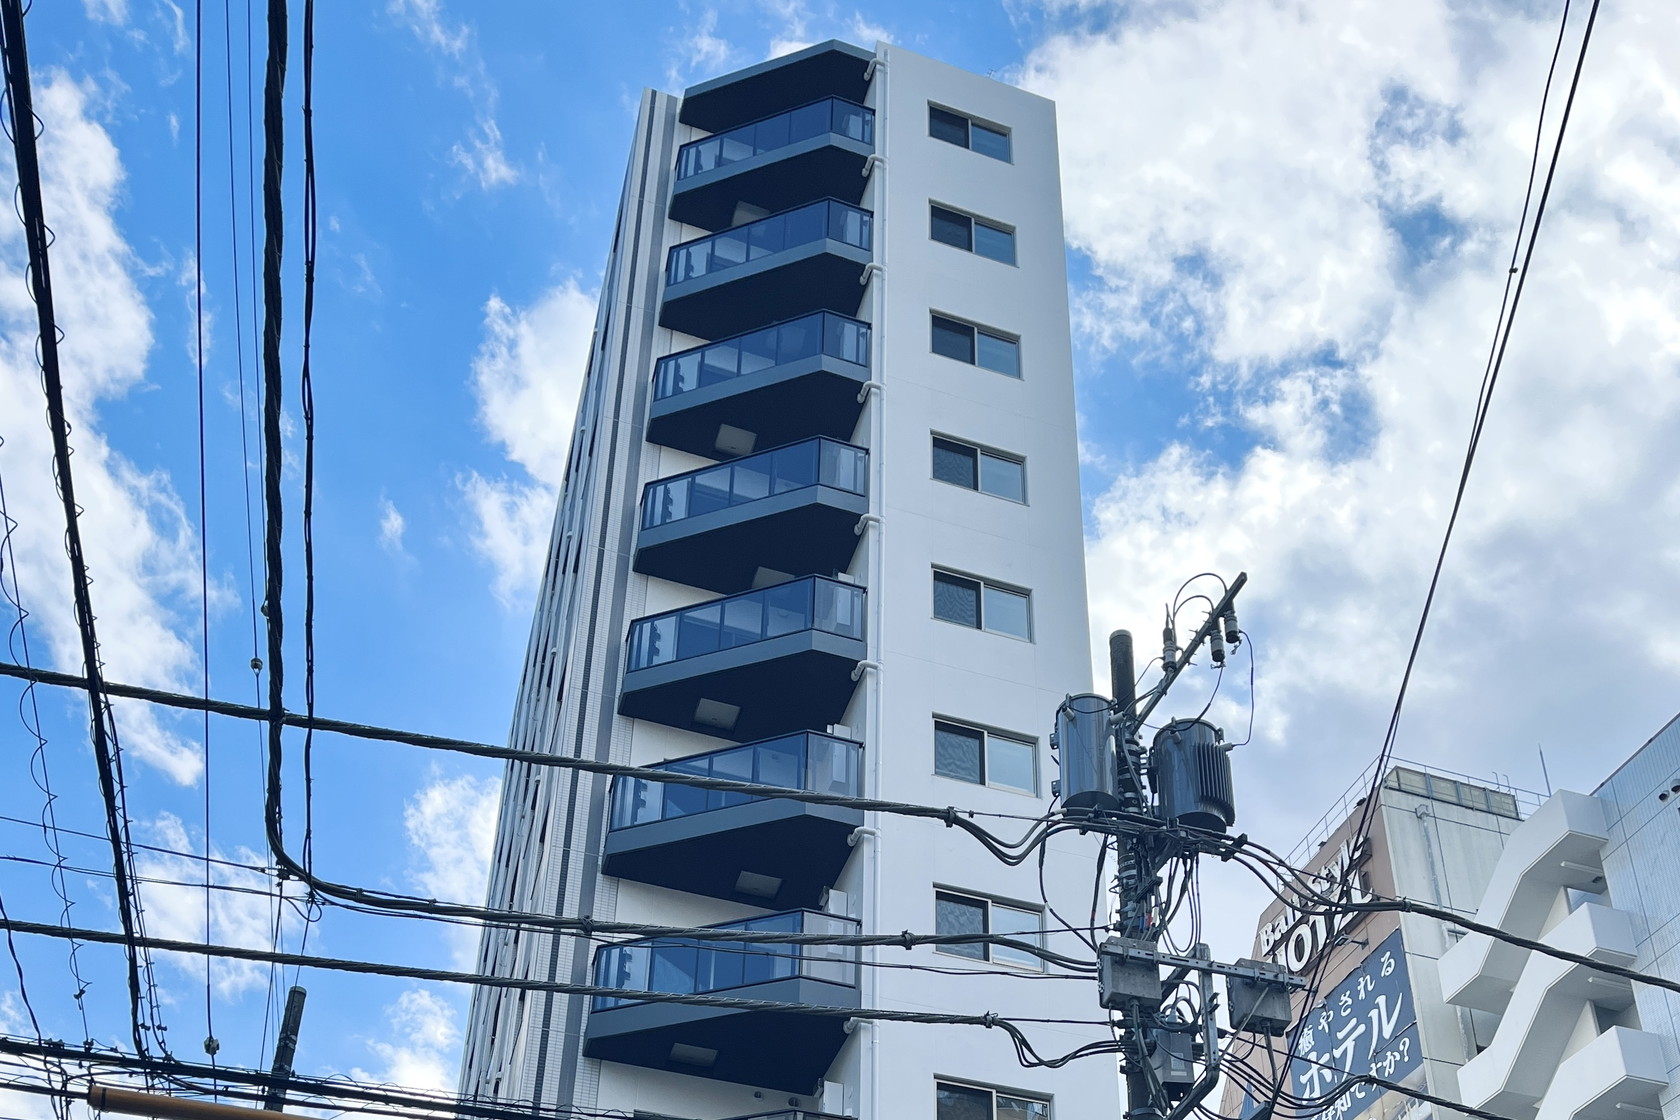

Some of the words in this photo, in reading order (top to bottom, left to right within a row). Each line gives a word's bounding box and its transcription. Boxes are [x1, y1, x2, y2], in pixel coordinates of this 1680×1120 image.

[1298, 951, 1395, 1056] 癒やされる
[1300, 992, 1403, 1105] ホテル
